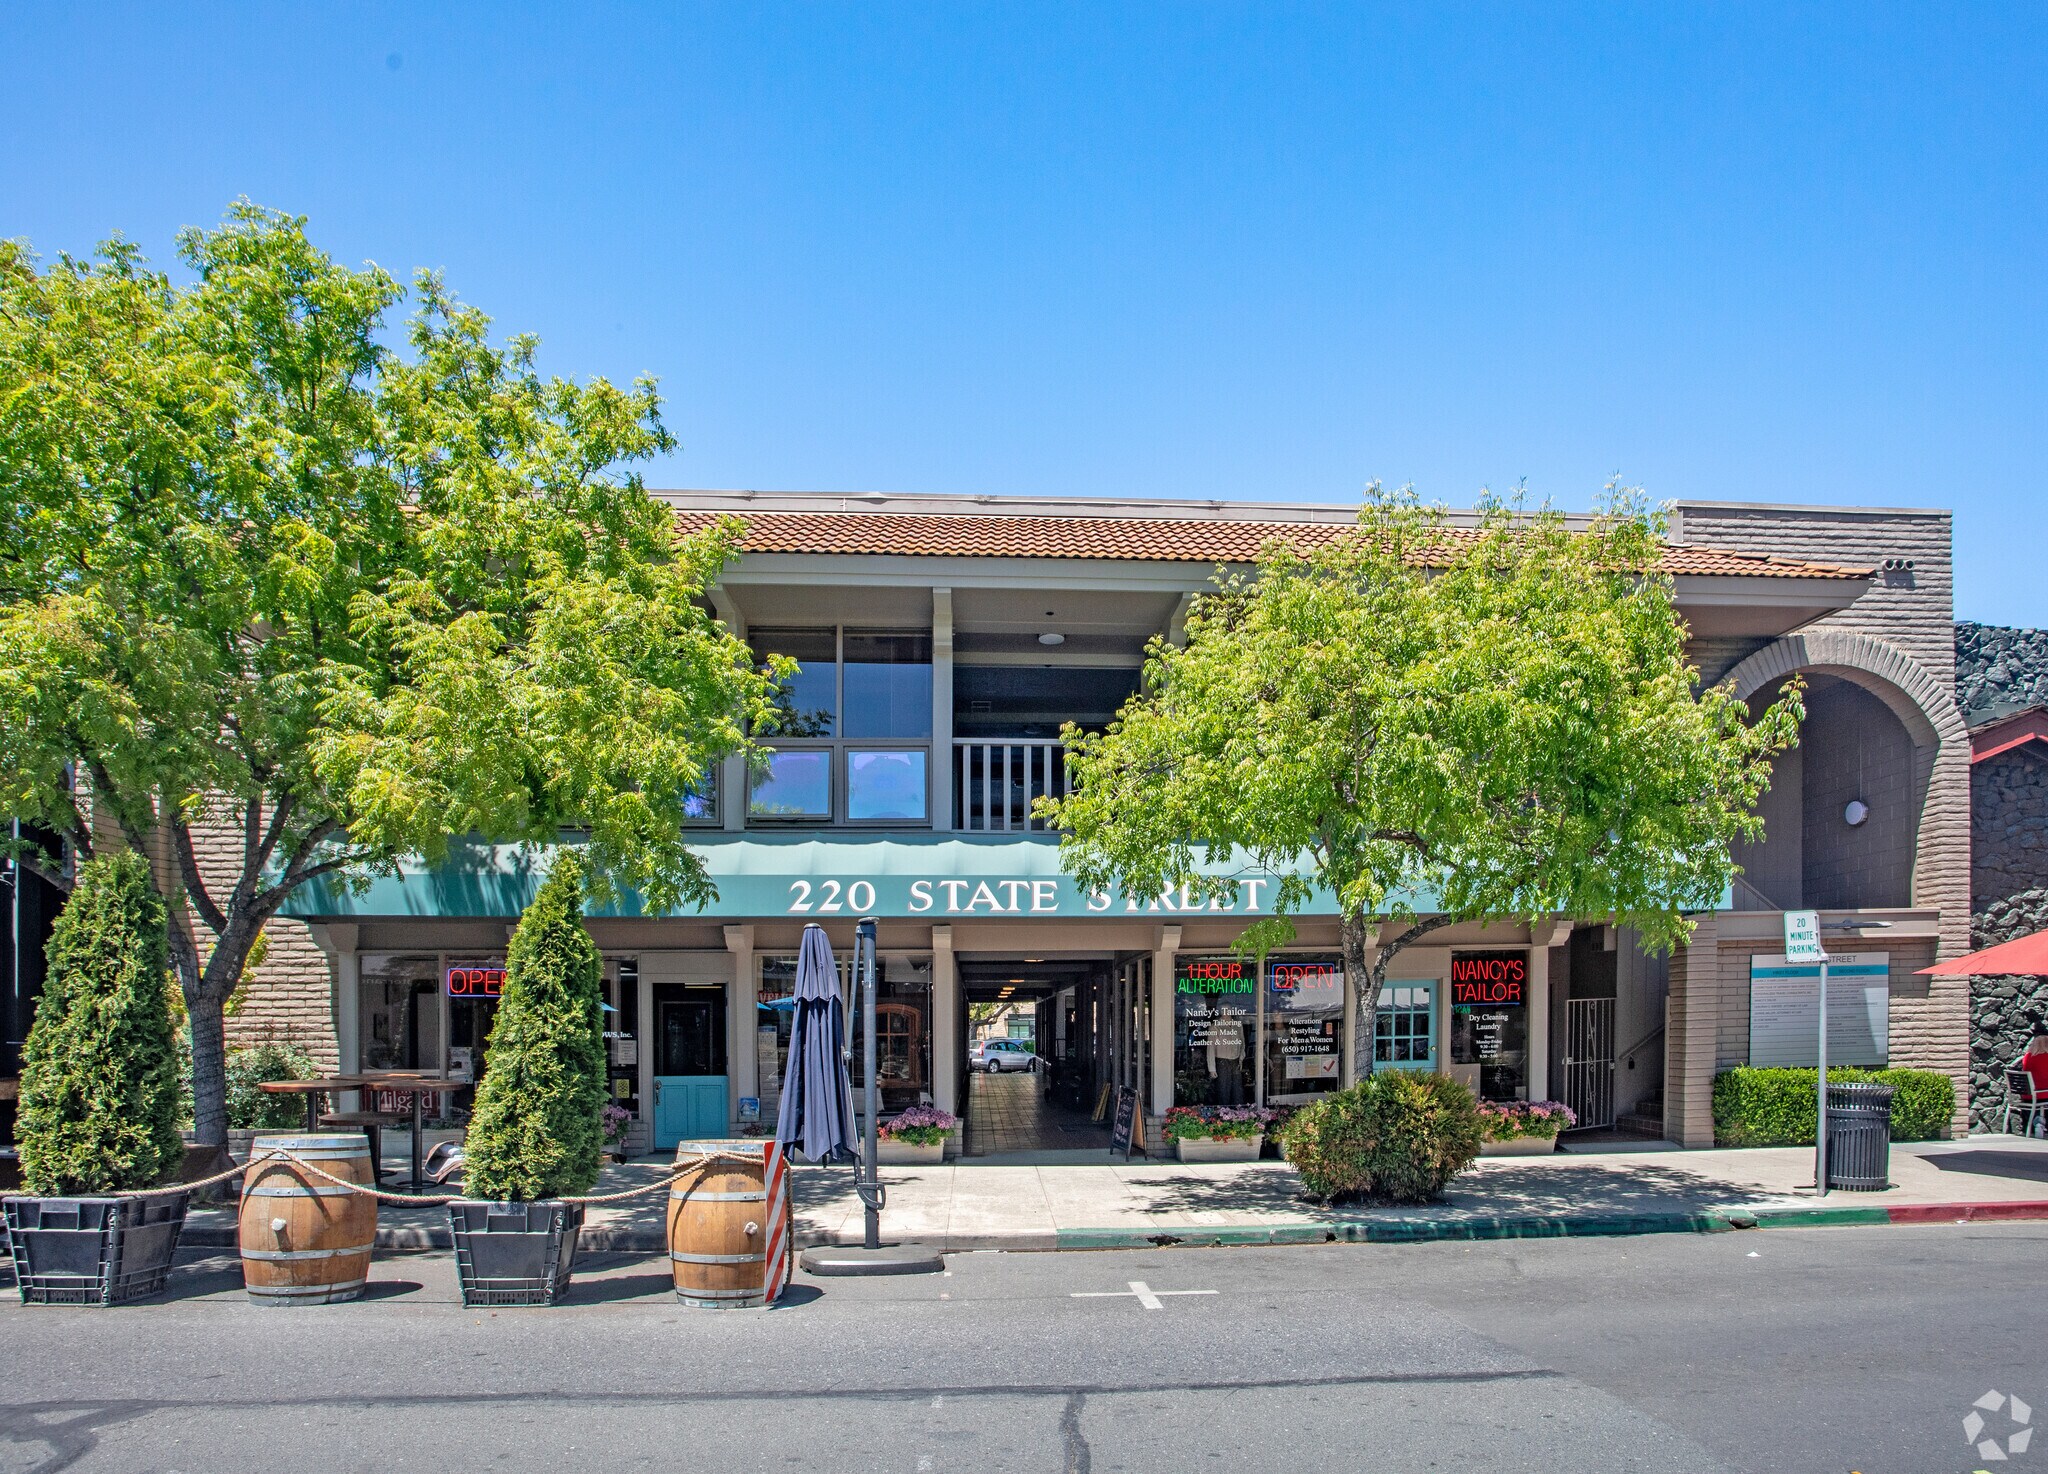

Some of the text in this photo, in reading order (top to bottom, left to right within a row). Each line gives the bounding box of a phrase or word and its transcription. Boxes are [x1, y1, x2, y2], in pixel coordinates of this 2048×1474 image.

[787, 879, 876, 912] 220
[908, 879, 1059, 912] STATE
[1797, 917, 1806, 928] 20
[1790, 931, 1814, 941] MINUTE
[1788, 944, 1817, 954] PARKING
[1828, 955, 1857, 963] STREET
[1187, 963, 1242, 979] 1 HOUR
[1453, 960, 1524, 980] NANCY'S
[1275, 966, 1333, 989] OPEN
[1177, 978, 1253, 994] ALTERATION
[1454, 983, 1520, 1001] TAILOR
[1186, 1007, 1247, 1018] Nancy's Tailor
[1213, 1019, 1242, 1027] Tailoring
[1291, 1027, 1320, 1035] Restyling
[1281, 1045, 1330, 1054] (650) 917-1648
[381, 1091, 433, 1113] Milgad
